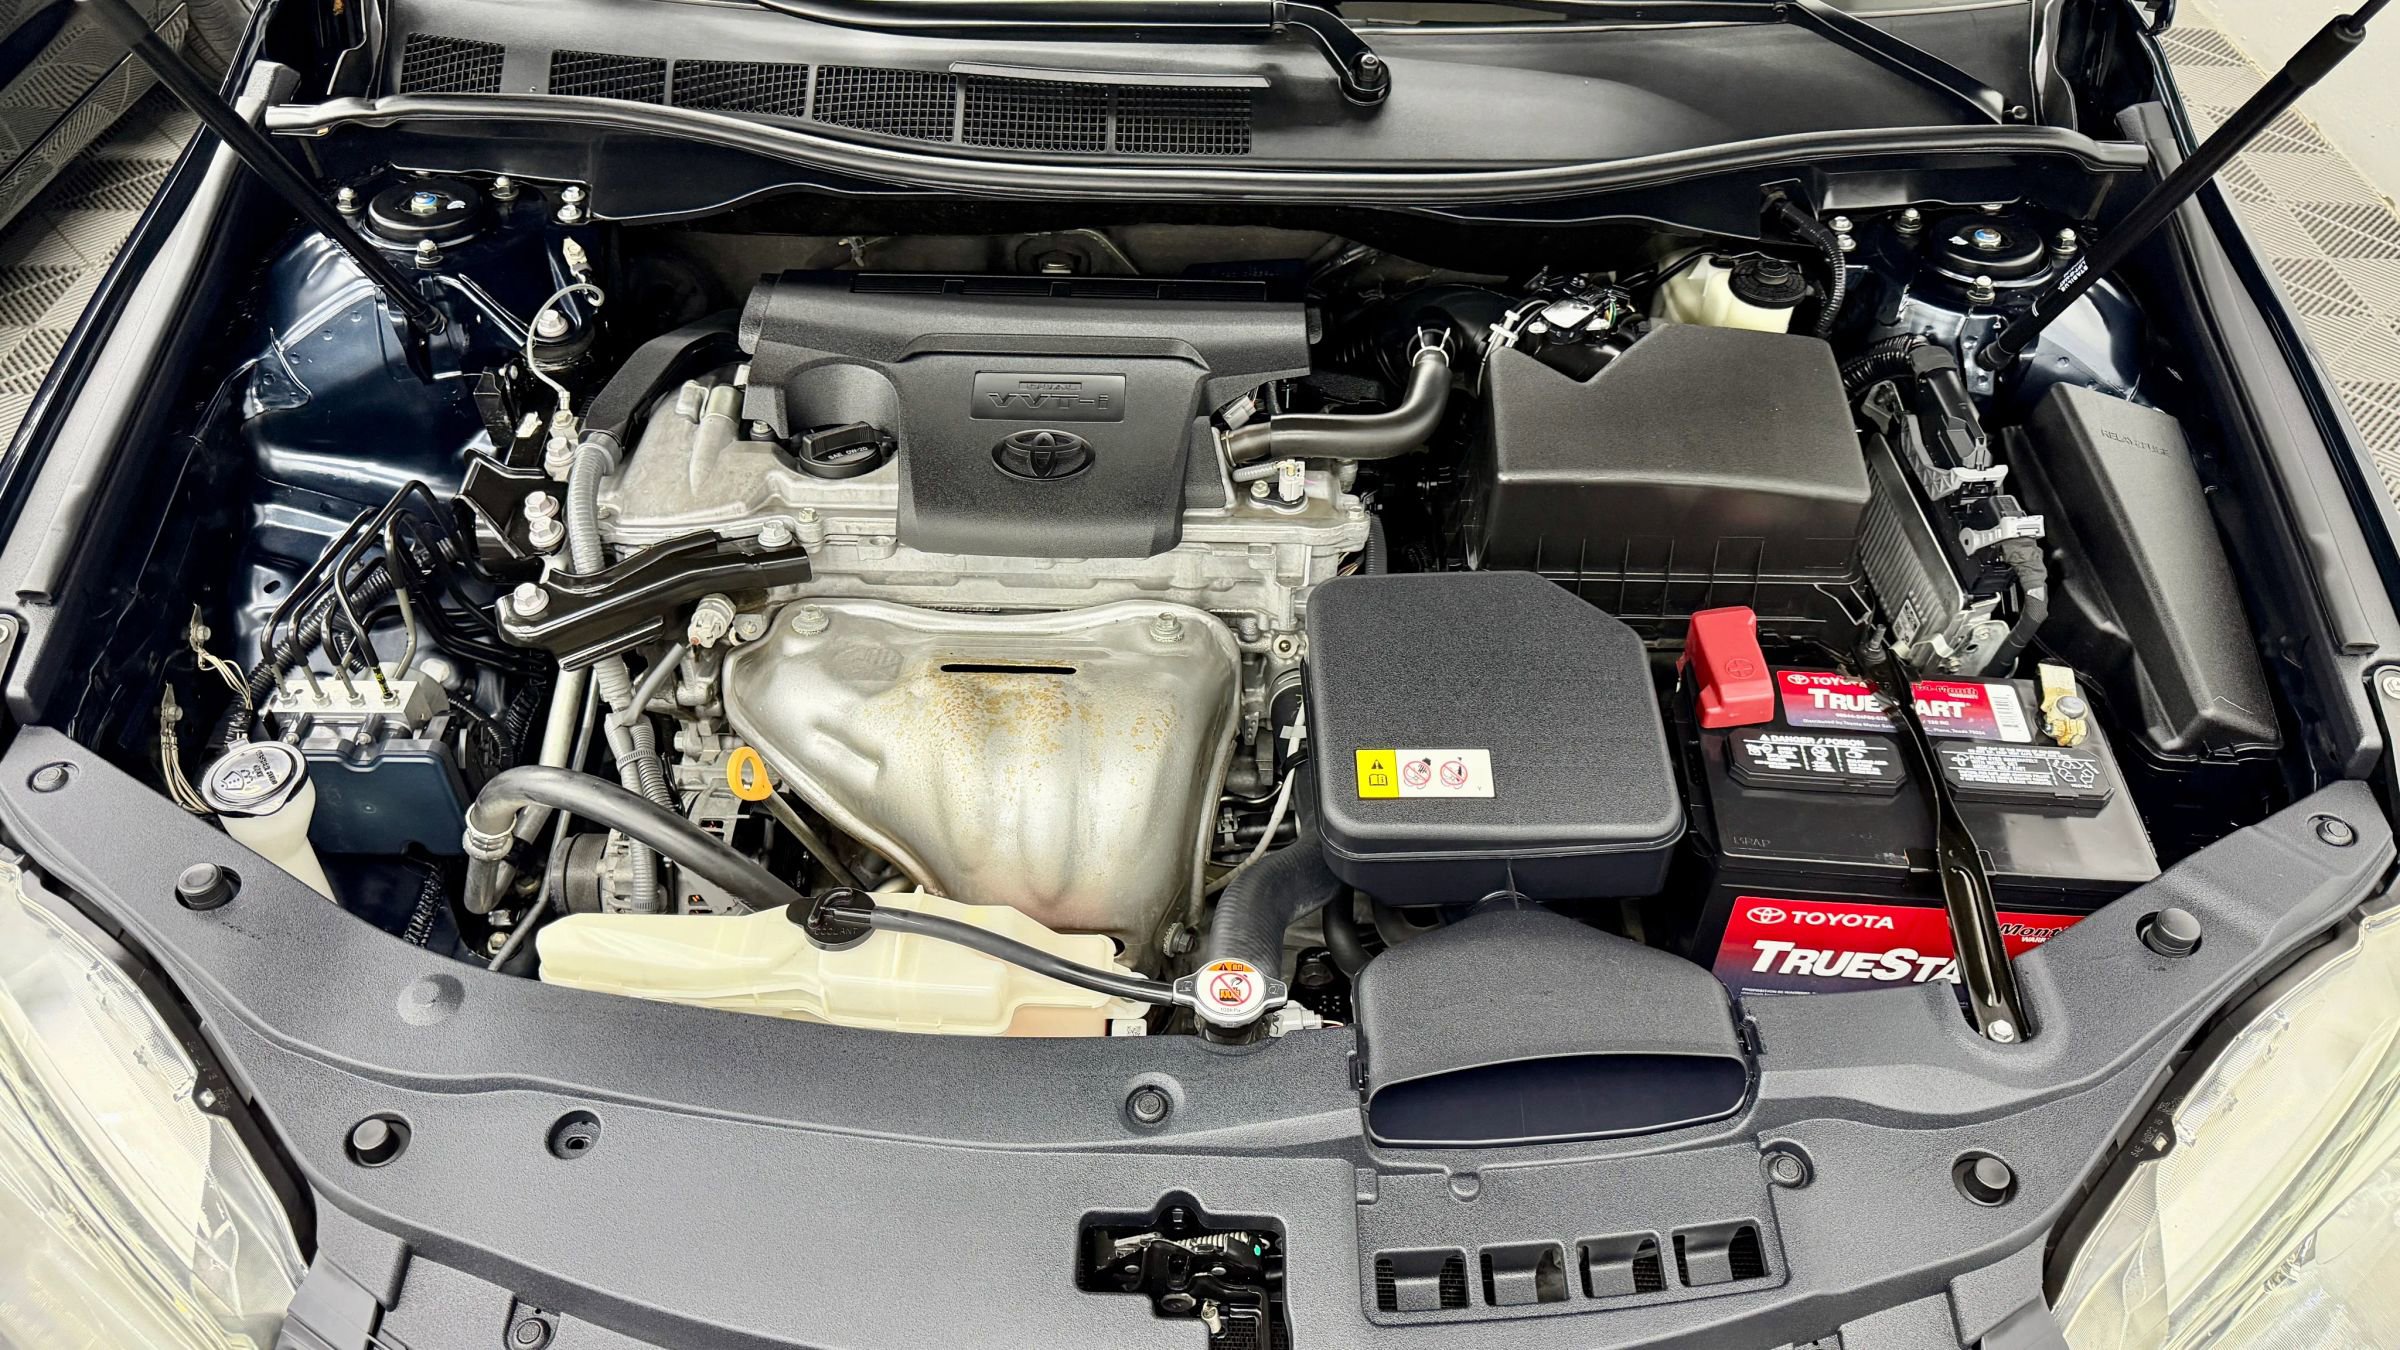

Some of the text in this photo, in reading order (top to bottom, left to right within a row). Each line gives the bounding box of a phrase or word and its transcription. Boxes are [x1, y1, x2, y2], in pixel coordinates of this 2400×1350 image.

[987, 391, 1109, 410] VVT-i
[827, 451, 844, 461] SAE
[1771, 734, 1815, 745] DANGER
[1825, 737, 1866, 747] POISON
[1791, 910, 1895, 930] TOYOTA
[814, 927, 858, 936] COOLANT
[2000, 922, 2070, 938] Mont
[1751, 939, 1963, 985] TRUESTA
